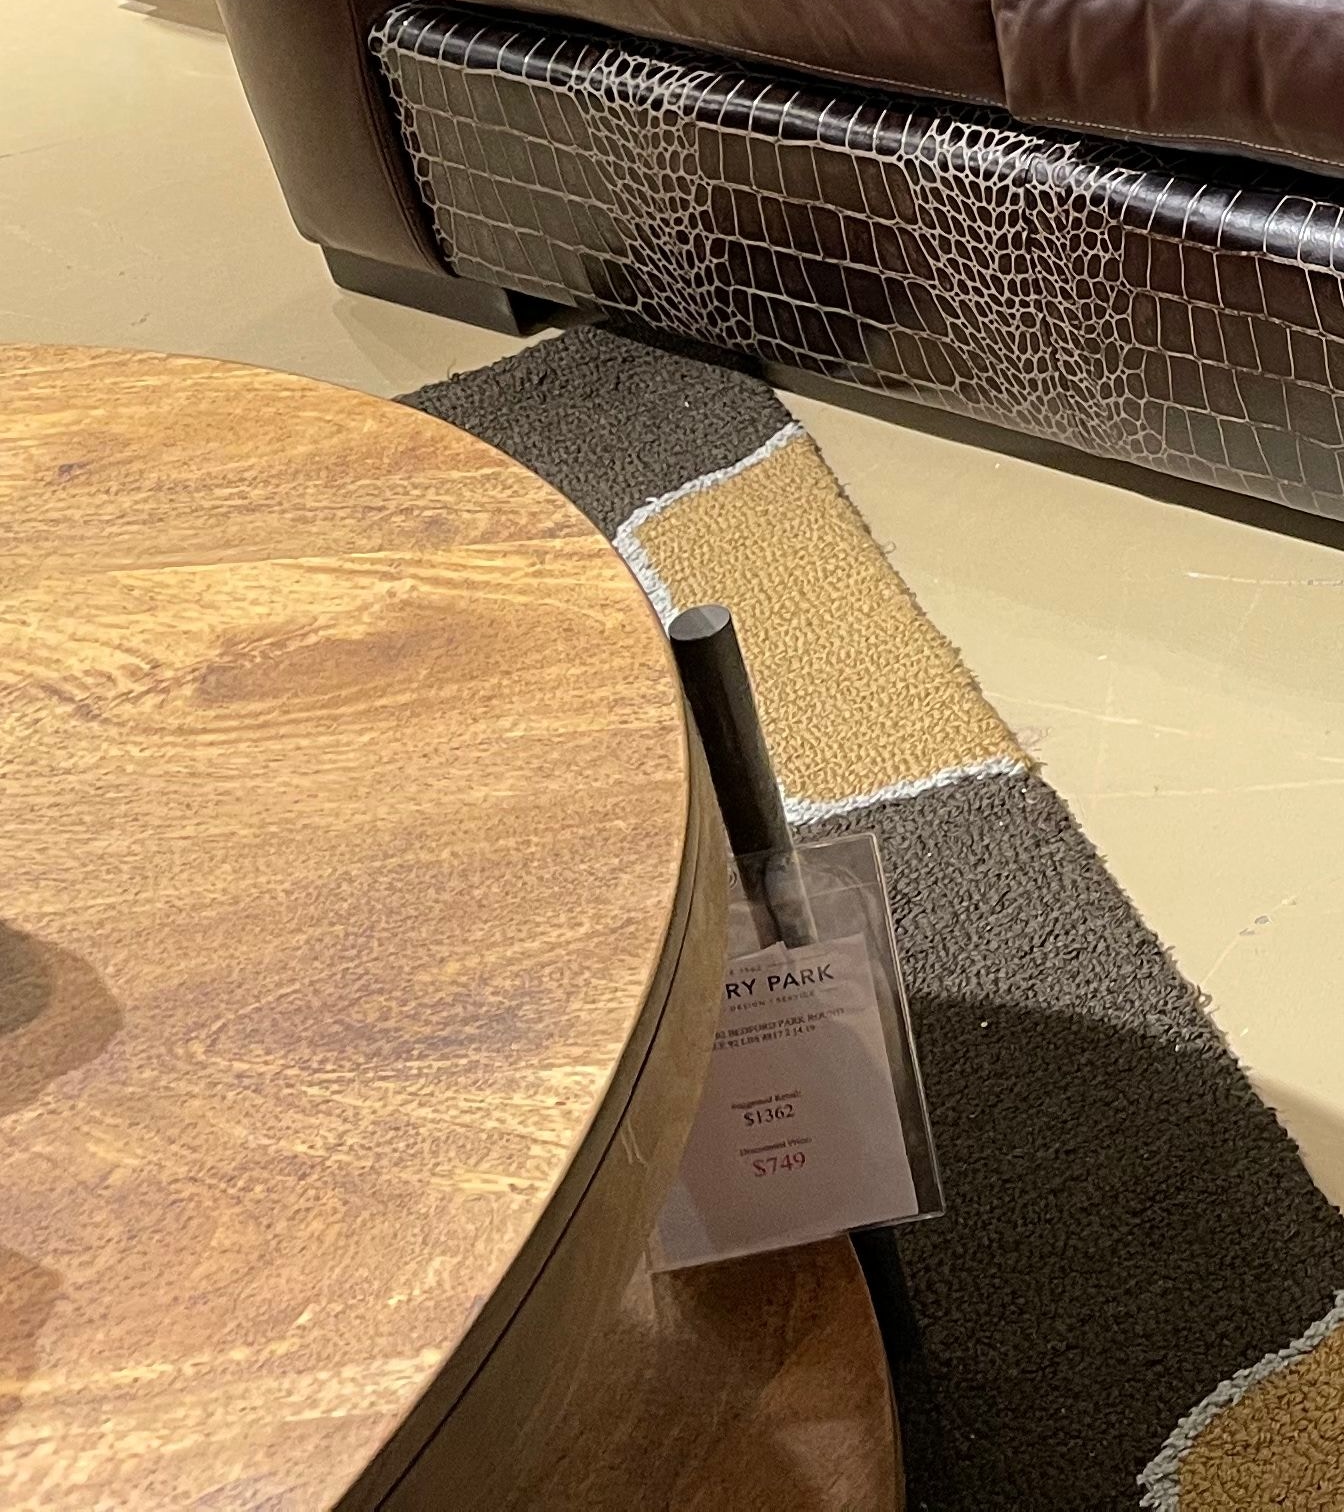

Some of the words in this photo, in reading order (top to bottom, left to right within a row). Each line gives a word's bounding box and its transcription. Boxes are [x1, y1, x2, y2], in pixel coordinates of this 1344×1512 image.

[767, 963, 834, 992] PARK
[778, 1016, 805, 1028] PARK
[744, 1104, 795, 1126] $1362
[752, 1151, 806, 1177] $749
